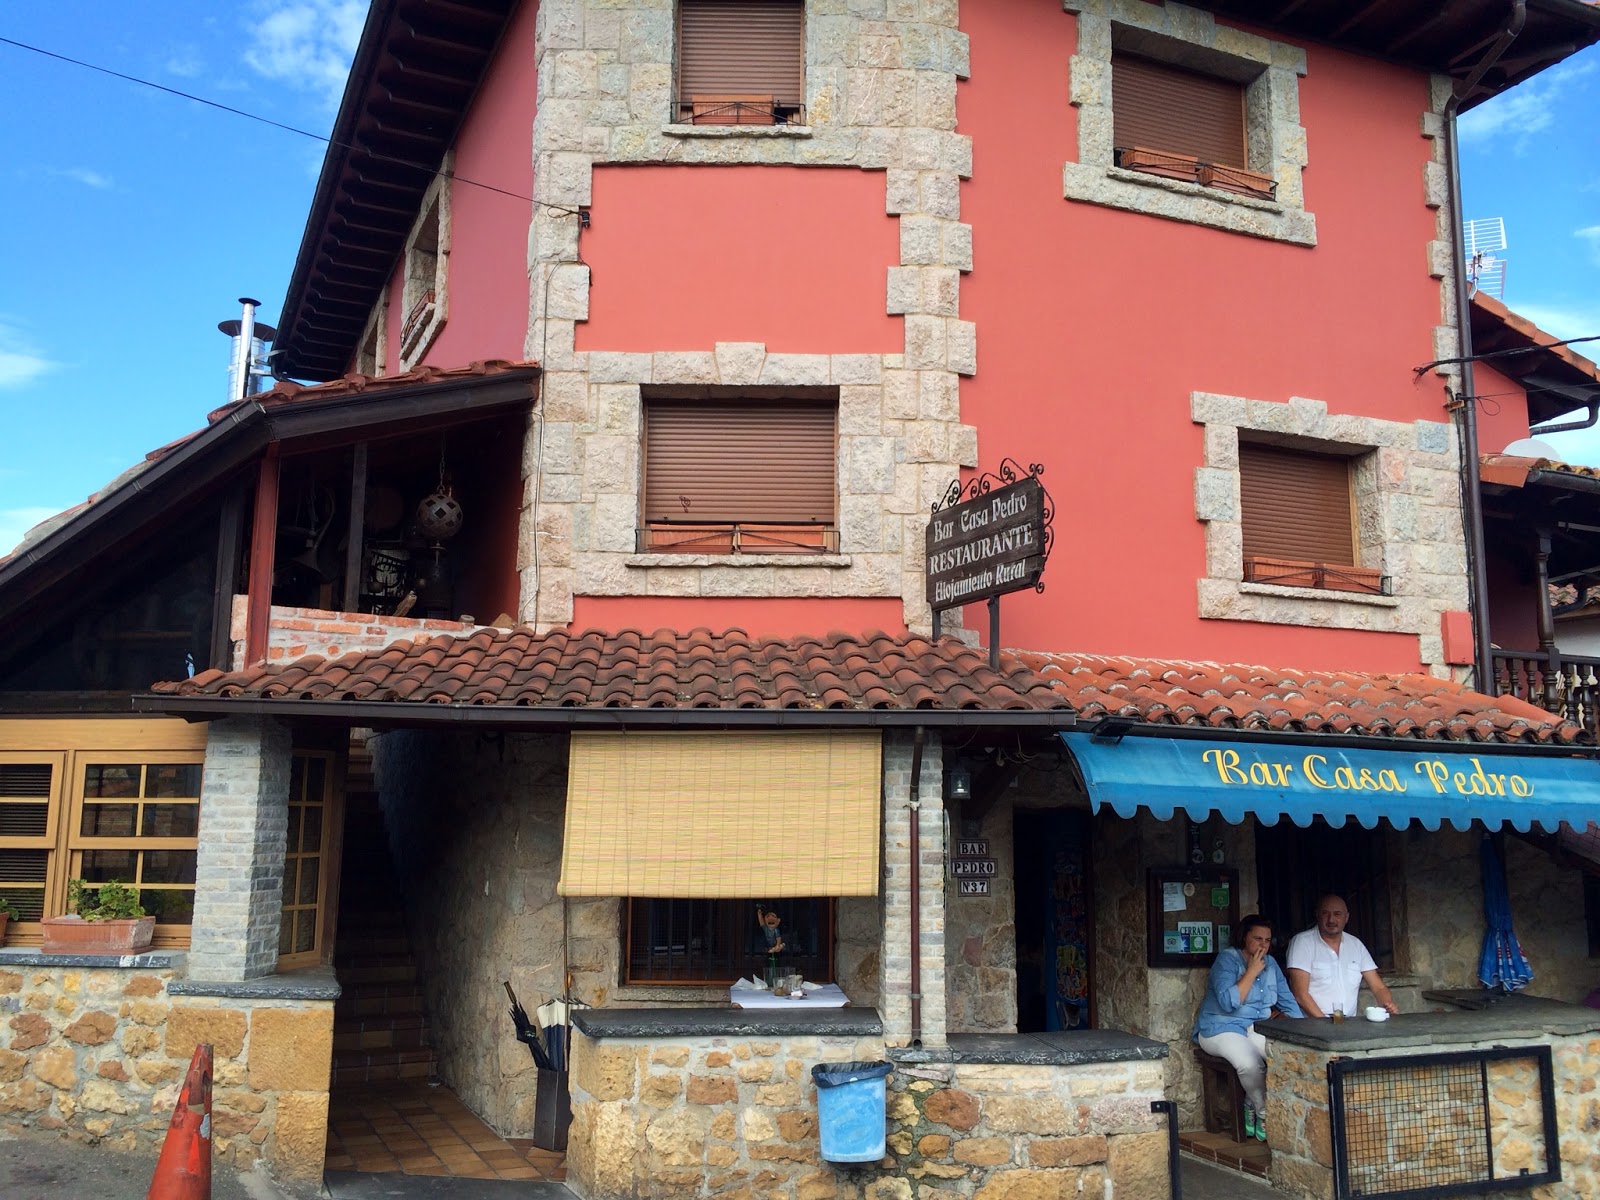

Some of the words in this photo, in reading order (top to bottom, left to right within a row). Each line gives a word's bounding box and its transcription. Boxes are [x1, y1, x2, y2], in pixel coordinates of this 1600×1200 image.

[934, 520, 954, 543] Bar
[961, 509, 988, 533] Casa
[992, 493, 1027, 522] Pedro
[929, 522, 1033, 575] RESTAURANTE
[935, 568, 993, 603] Alojamiento
[995, 559, 1026, 585] Rural
[1202, 749, 1293, 787] Bar
[1303, 754, 1408, 792] Casa
[1414, 758, 1535, 797] Pedro
[954, 862, 994, 873] PEDRO
[961, 843, 985, 854] BAR
[1180, 926, 1211, 936] CERRADO
